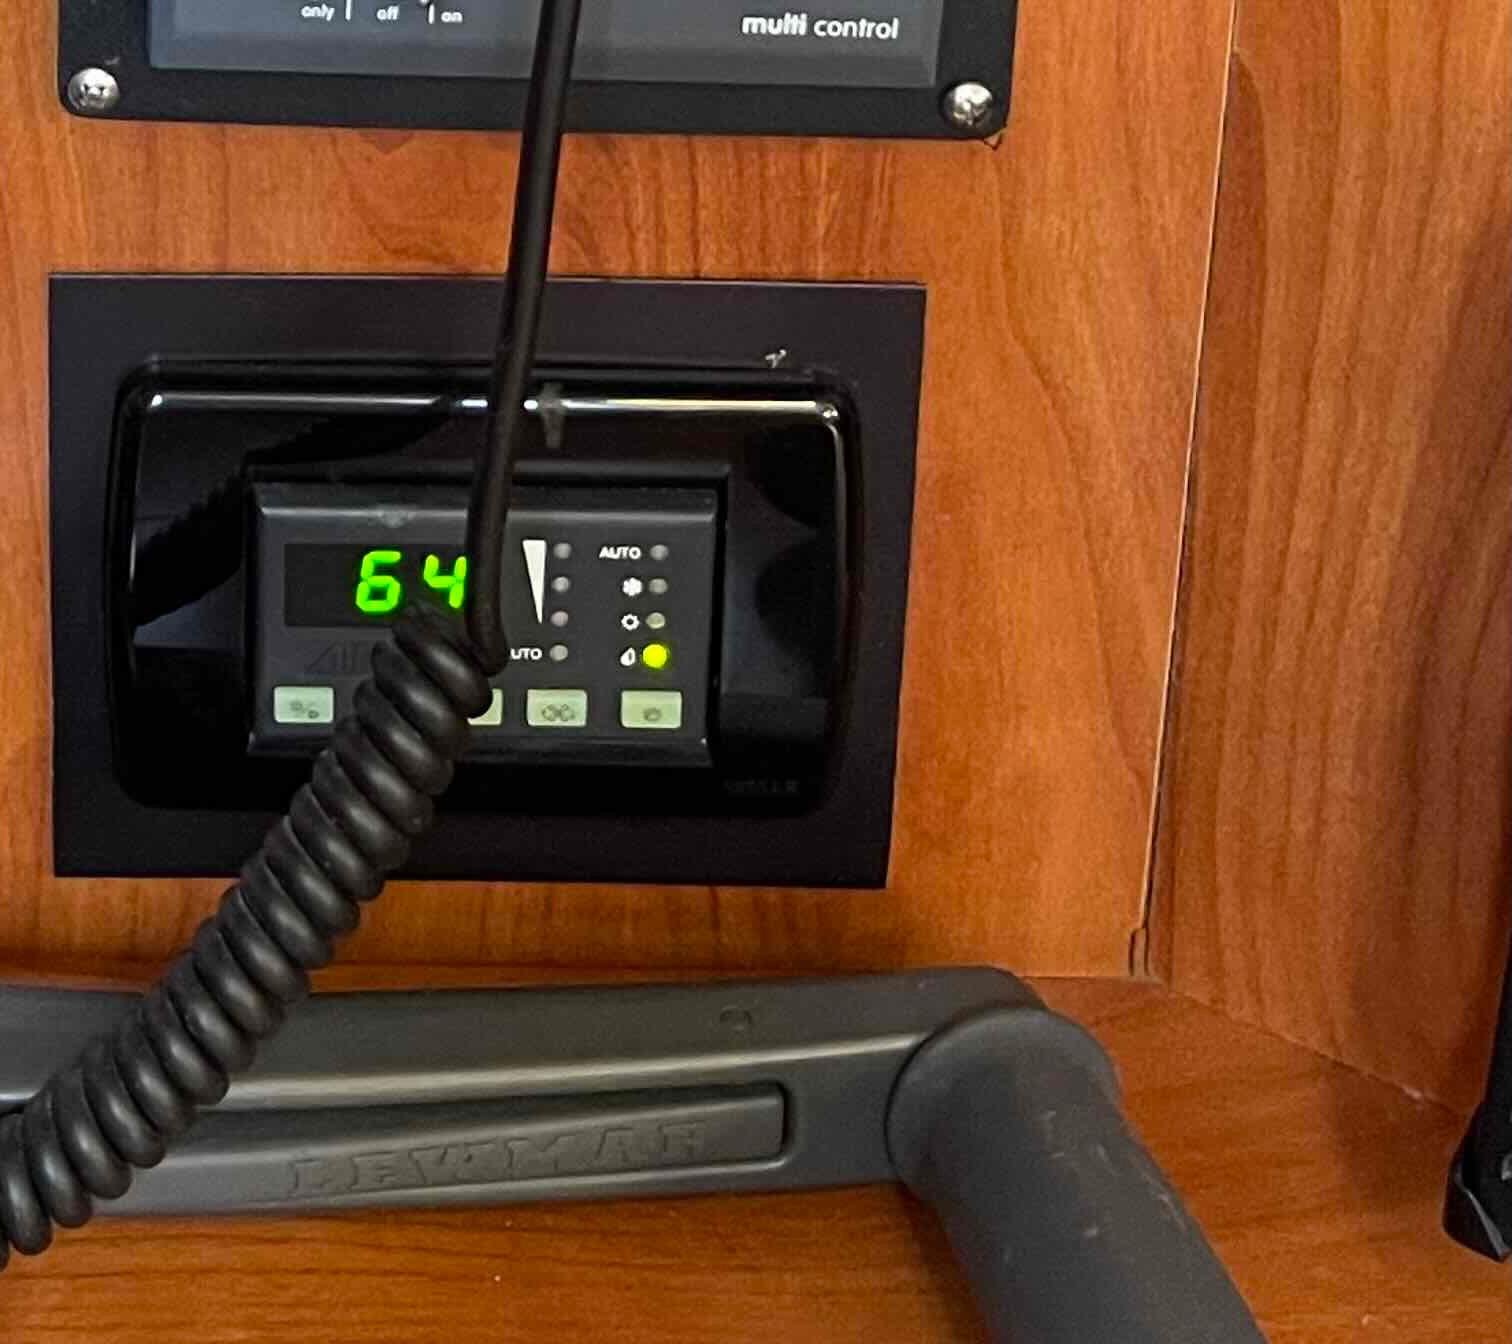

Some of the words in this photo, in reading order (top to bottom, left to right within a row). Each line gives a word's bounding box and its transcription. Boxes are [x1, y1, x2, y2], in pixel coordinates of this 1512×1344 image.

[301, 4, 335, 21] only
[377, 5, 399, 20] off
[441, 11, 462, 23] on
[742, 13, 806, 36] multi
[814, 17, 898, 39] control
[600, 546, 641, 559] AUTO
[356, 551, 467, 612] 64
[510, 647, 542, 660] UTO
